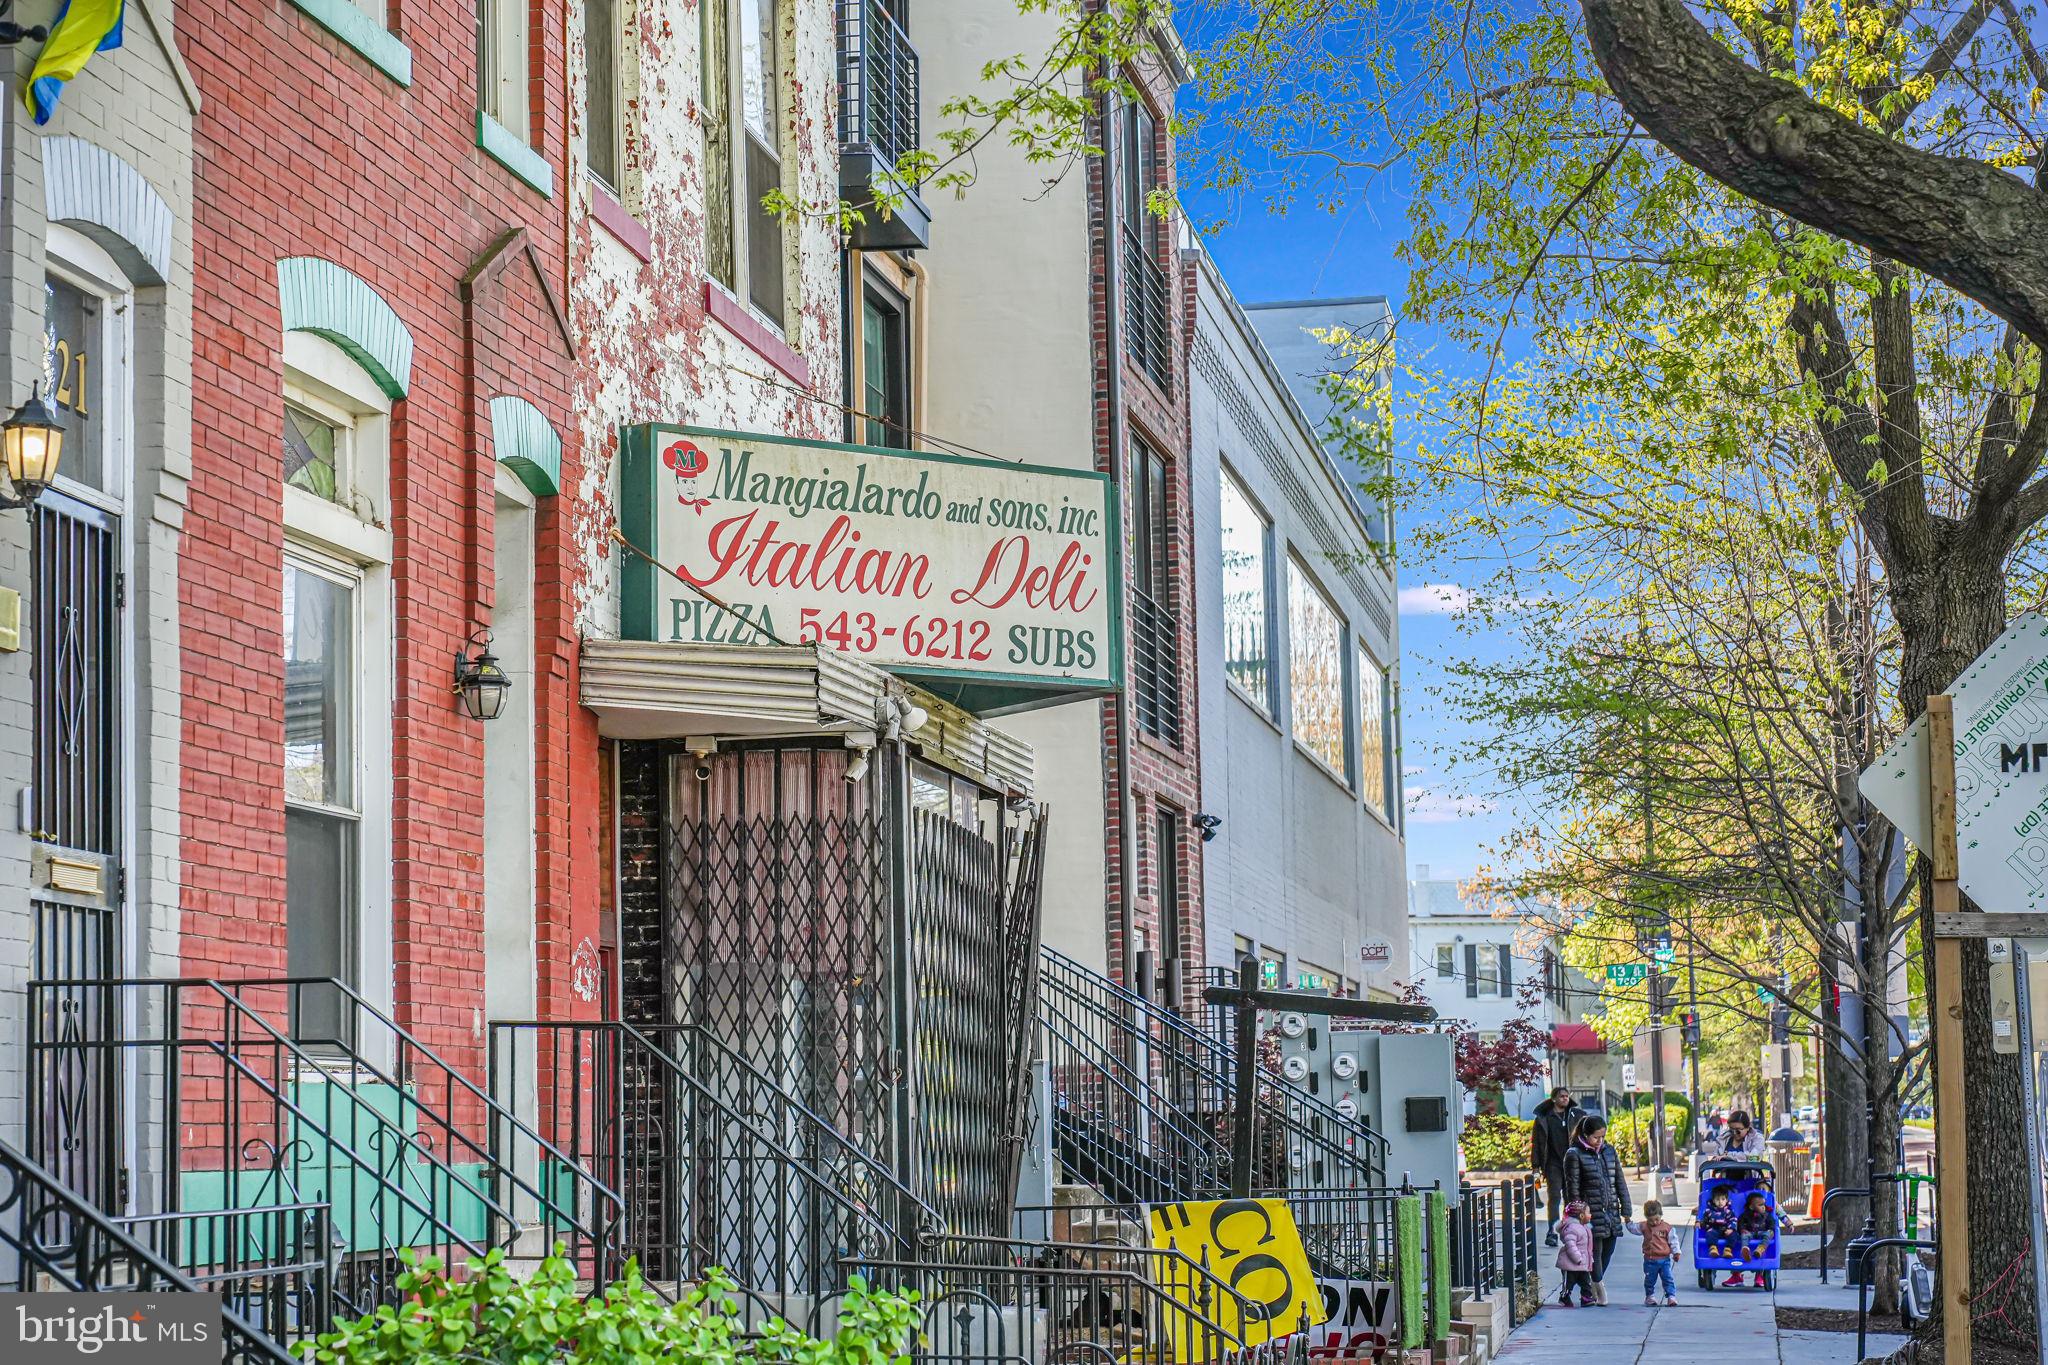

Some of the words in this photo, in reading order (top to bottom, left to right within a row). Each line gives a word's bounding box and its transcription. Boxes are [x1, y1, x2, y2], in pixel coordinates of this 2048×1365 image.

[55, 339, 89, 417] 21
[674, 448, 698, 469] M
[712, 448, 942, 520] Mangialardo
[946, 497, 983, 525] and
[986, 497, 1052, 534] sons,
[1055, 496, 1099, 537] inc.
[676, 507, 933, 600] Italian
[950, 536, 1098, 614] Deli
[669, 598, 777, 648] PIZZA
[800, 607, 993, 661] 543-6212
[1007, 624, 1097, 670] SUBS
[1963, 682, 2026, 746] PRINTABLE
[1965, 697, 1994, 726] PRINTING
[1990, 686, 2006, 701] FOR
[1361, 946, 1389, 956] DCPT
[1612, 966, 1626, 977] 13
